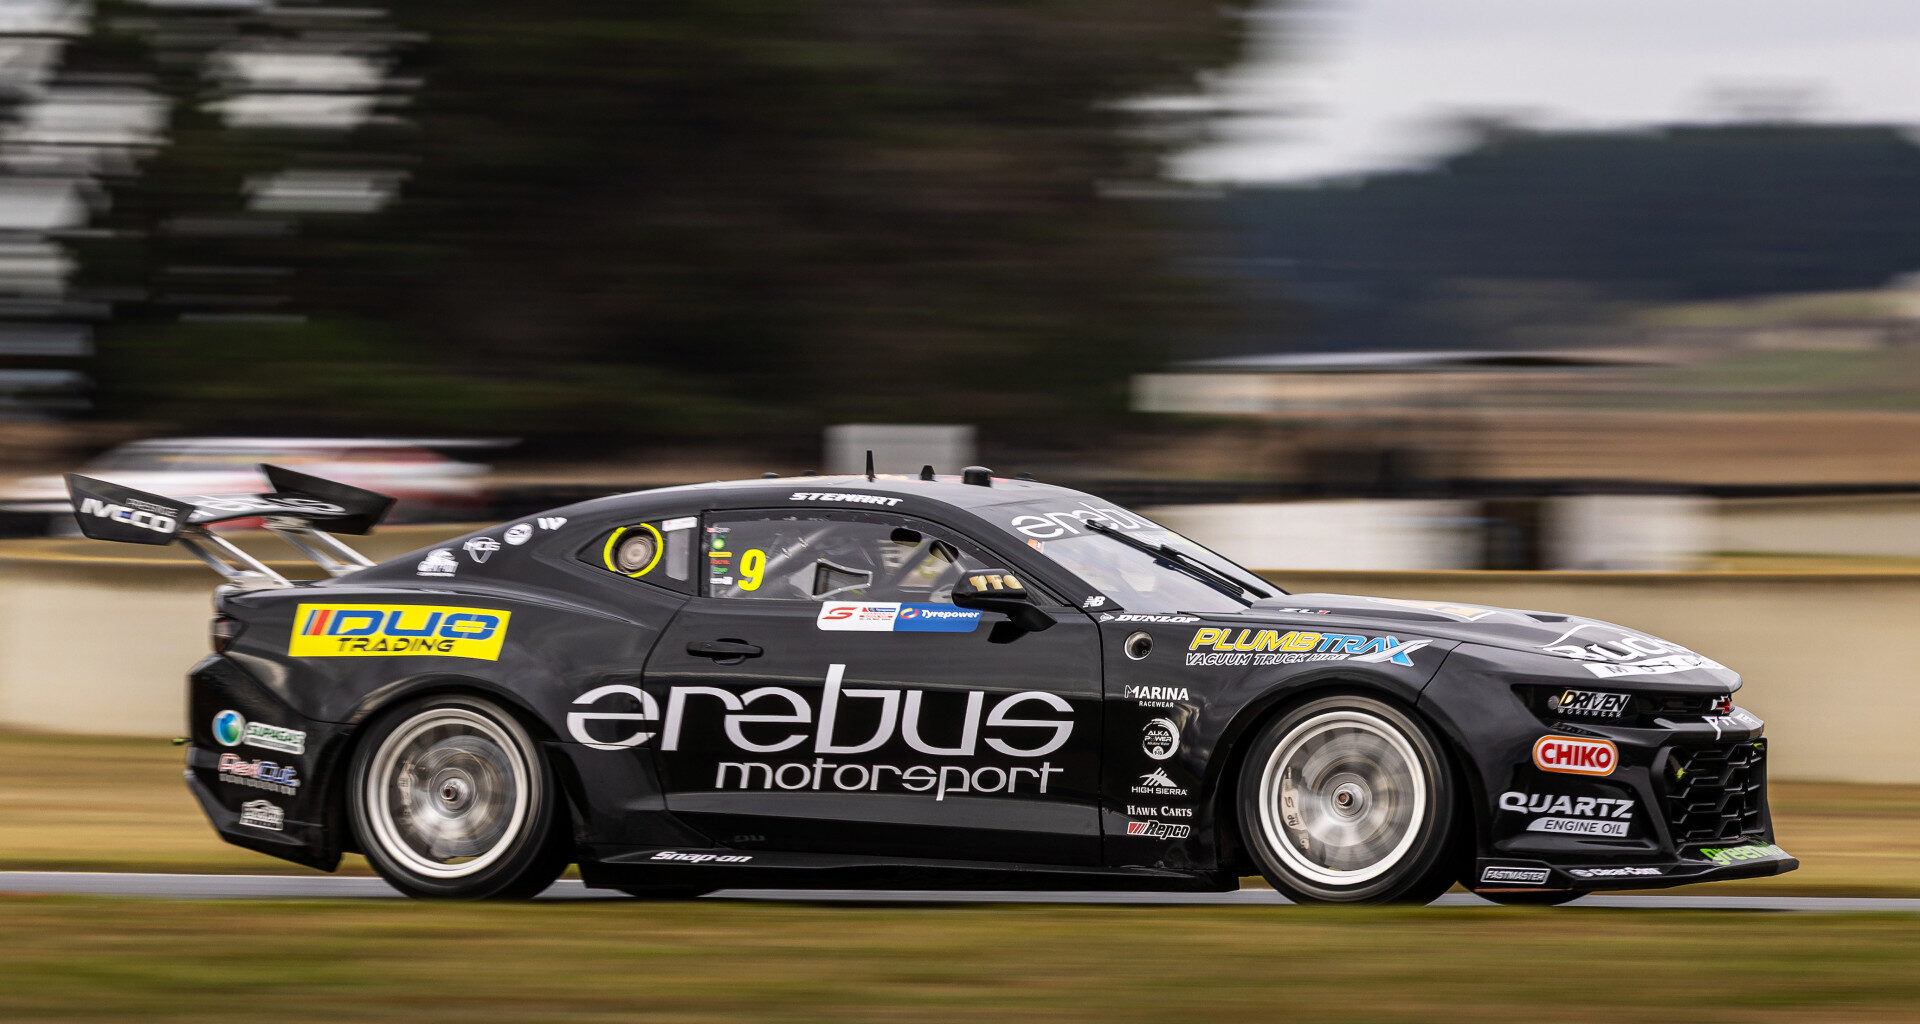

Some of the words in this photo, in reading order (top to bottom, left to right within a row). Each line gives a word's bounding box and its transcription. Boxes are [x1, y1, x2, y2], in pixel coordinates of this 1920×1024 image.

[789, 492, 903, 507] STEWART
[738, 549, 766, 591] 9
[921, 609, 980, 620] Tyrepower
[1115, 614, 1201, 624] DUNLOP
[326, 609, 500, 640] DUO
[338, 637, 457, 653] TRADING
[1188, 627, 1434, 667] PLUMBTRAX
[1186, 652, 1253, 666] VACUUM
[1253, 653, 1310, 666] TRUCK
[1124, 684, 1189, 701] MARINA
[1560, 690, 1628, 711] DRIVEN
[566, 663, 1076, 757] erebus
[1139, 700, 1174, 708] RACEWEAR
[1557, 708, 1622, 718] WORKWEAR
[1540, 742, 1612, 769] CHIKO
[715, 757, 1064, 801] motorsport
[1131, 786, 1154, 794] HIGH
[1155, 787, 1187, 796] SIERRA
[1499, 791, 1635, 819] QUARTZ
[1144, 820, 1190, 840] Repco
[1544, 819, 1599, 833] ENGINE
[1601, 822, 1624, 835] OIL
[650, 851, 753, 863] Snap-on
[1486, 870, 1546, 881] FASTMASTER
